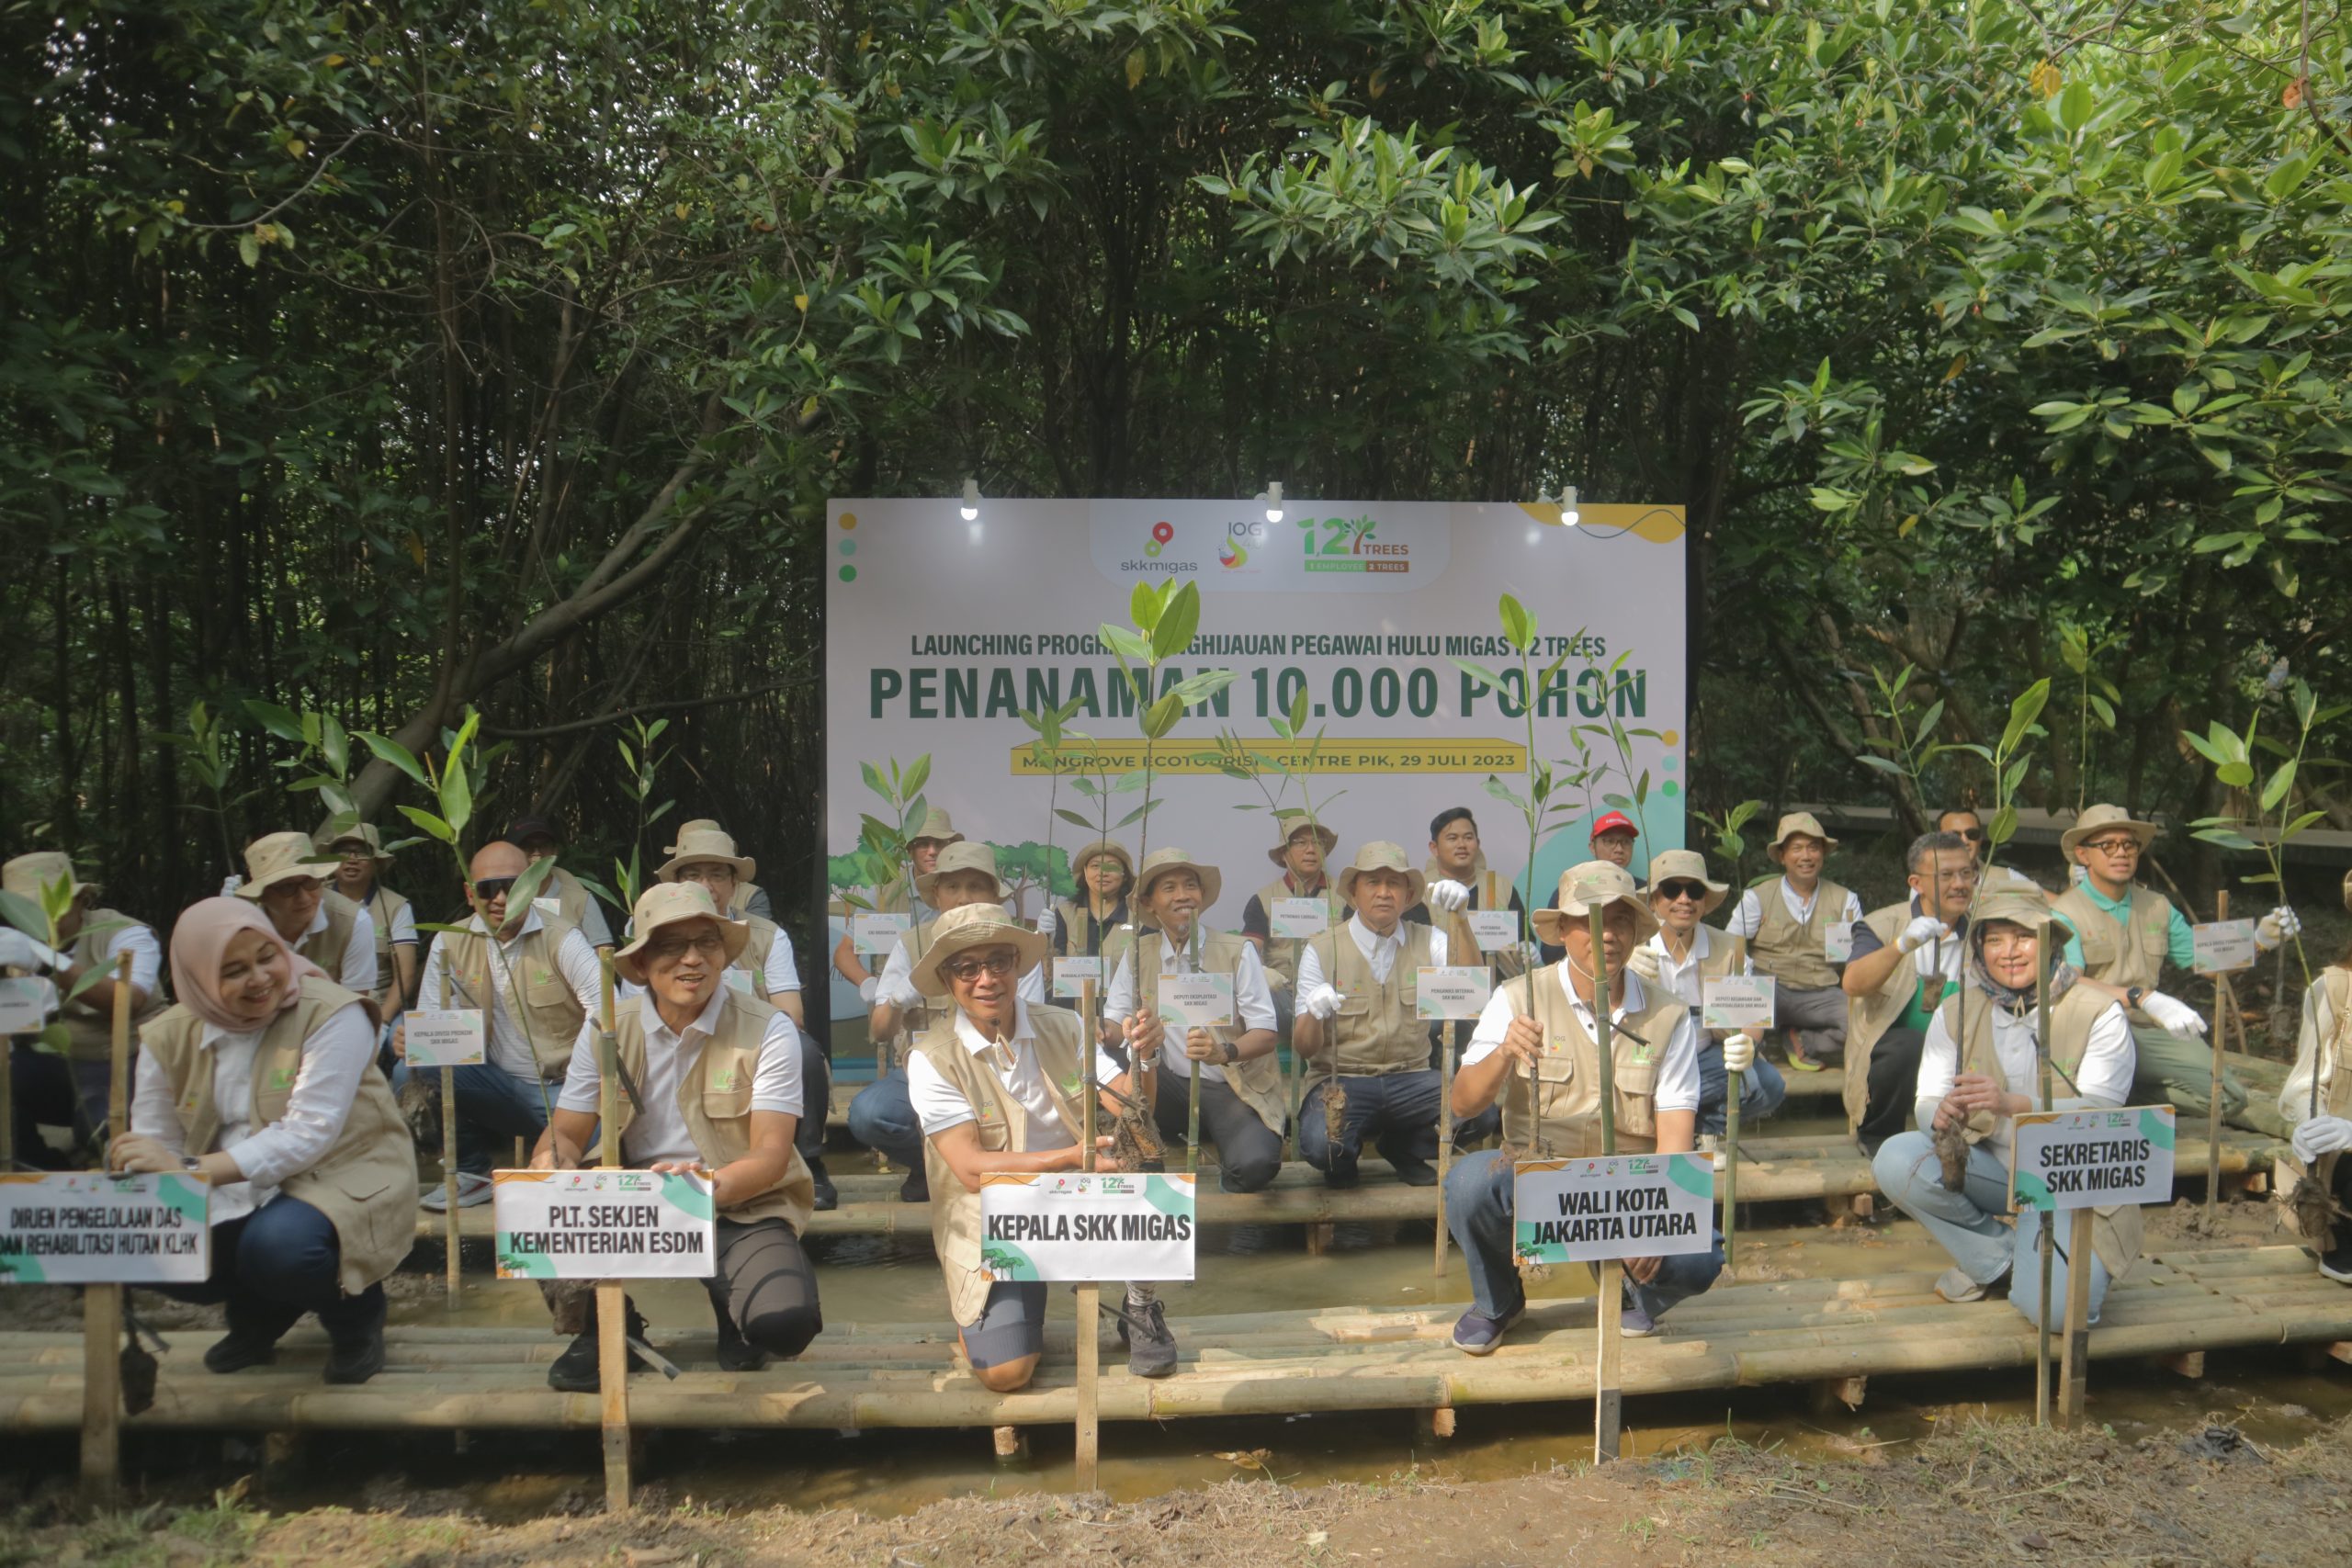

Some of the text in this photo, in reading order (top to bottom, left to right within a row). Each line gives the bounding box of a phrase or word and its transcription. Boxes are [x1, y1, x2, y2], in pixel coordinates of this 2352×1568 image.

[1228, 522, 1262, 536] IOG
[1363, 544, 1408, 556] TREES
[1377, 563, 1406, 571] TREES
[911, 635, 1033, 655] LAUNCHING
[1037, 635, 1114, 656] PROGR
[1292, 635, 1383, 656] PEGAWAI
[1387, 635, 1441, 656] HULU
[1445, 636, 1510, 657] MIGAS
[1544, 637, 1606, 657] TREES
[870, 666, 1646, 718] PENANAMAN 10.000 POHON
[1023, 756, 1136, 768] MNGROVE
[1277, 755, 1354, 767] CENTRE
[1358, 755, 1395, 769] PIK,
[1400, 755, 1422, 767] 29
[1427, 755, 1468, 767] JULI
[1472, 755, 1515, 767] 2023
[2040, 1139, 2151, 1168] SEKRETARIS
[2045, 1166, 2145, 1193] SKK MIGAS
[1558, 1187, 1668, 1216] WALI KOTA
[10, 1206, 183, 1229] DIRJEN PENGELOLAAN DAS
[548, 1205, 659, 1228] PLT. SEKJEN
[989, 1214, 1191, 1241] KEPALA SKK MIGAS
[1532, 1213, 1697, 1245] JAKARTA UTARA
[27, 1234, 115, 1255] REHABILITASI
[118, 1234, 160, 1255] HUTAN
[164, 1233, 198, 1255] KLHK
[510, 1232, 703, 1254] KEMENTERIAN ESDM
